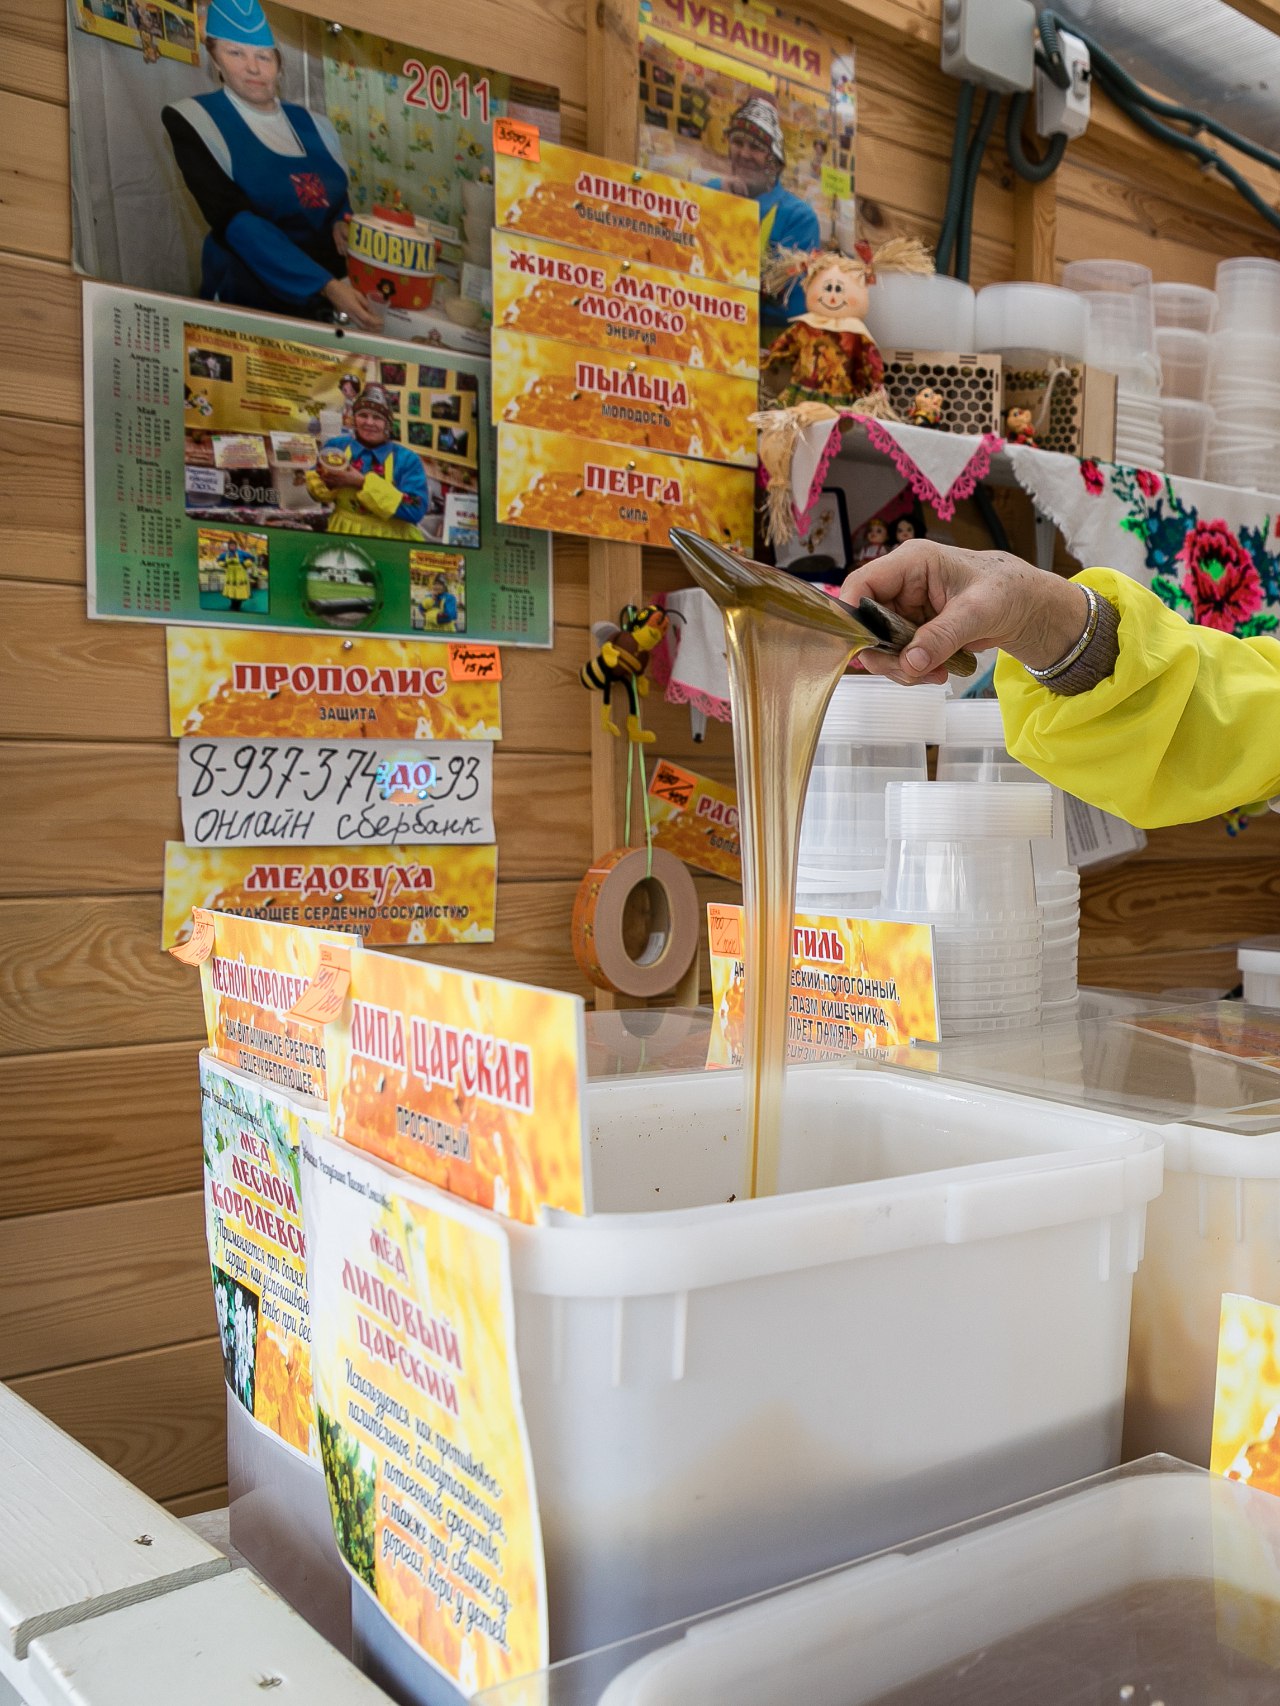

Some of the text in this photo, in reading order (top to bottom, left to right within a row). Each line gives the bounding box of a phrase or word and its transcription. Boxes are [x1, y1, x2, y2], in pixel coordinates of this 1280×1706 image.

[403, 59, 490, 124] 2011
[576, 173, 699, 230] АПИТОНУС
[577, 206, 697, 247] ОБЩЕУКРЕПЛЯЮЩЕЕ
[510, 251, 748, 322] ЖИВОЕ МАТОЧНОЕ
[580, 295, 685, 333] МОЛОКО
[606, 322, 657, 345] ЭНЕРГИЯ
[576, 362, 688, 410] ПЫЛЬЦА
[602, 404, 671, 428] МОЛОДОСТЬ
[585, 465, 683, 504] ПЕРГА
[619, 507, 649, 522] СИЛА
[234, 664, 447, 695] ПРОПОЛИС
[319, 707, 377, 721] ЗАЩИТА
[246, 865, 434, 903] МЕДОВУХА
[793, 928, 843, 960] ГИЛЬ
[212, 957, 249, 999] ЛЕСНОЙ
[821, 1000, 889, 1030] КИШЕЧНИКА,
[226, 1018, 327, 1070] КАК ВИТАМИННОЕ СРЕДСТВО
[351, 1001, 532, 1111] ЛИПА ЦАРСКАЯ
[240, 1129, 271, 1167] МЁД
[396, 1105, 471, 1163] ПРОСТУДНЫЙ
[232, 1153, 298, 1215] ЛЕСНОЙ
[218, 1216, 265, 1264] Применяется
[267, 1253, 280, 1277] при
[225, 1248, 249, 1280] сердца,
[250, 1265, 263, 1287] как
[369, 1227, 409, 1283] МЁД
[342, 1257, 462, 1371] ЛИПОВЫЙ
[357, 1314, 459, 1416] ЦАРСКИЙ
[345, 1358, 411, 1428] Используется
[415, 1417, 434, 1446] как
